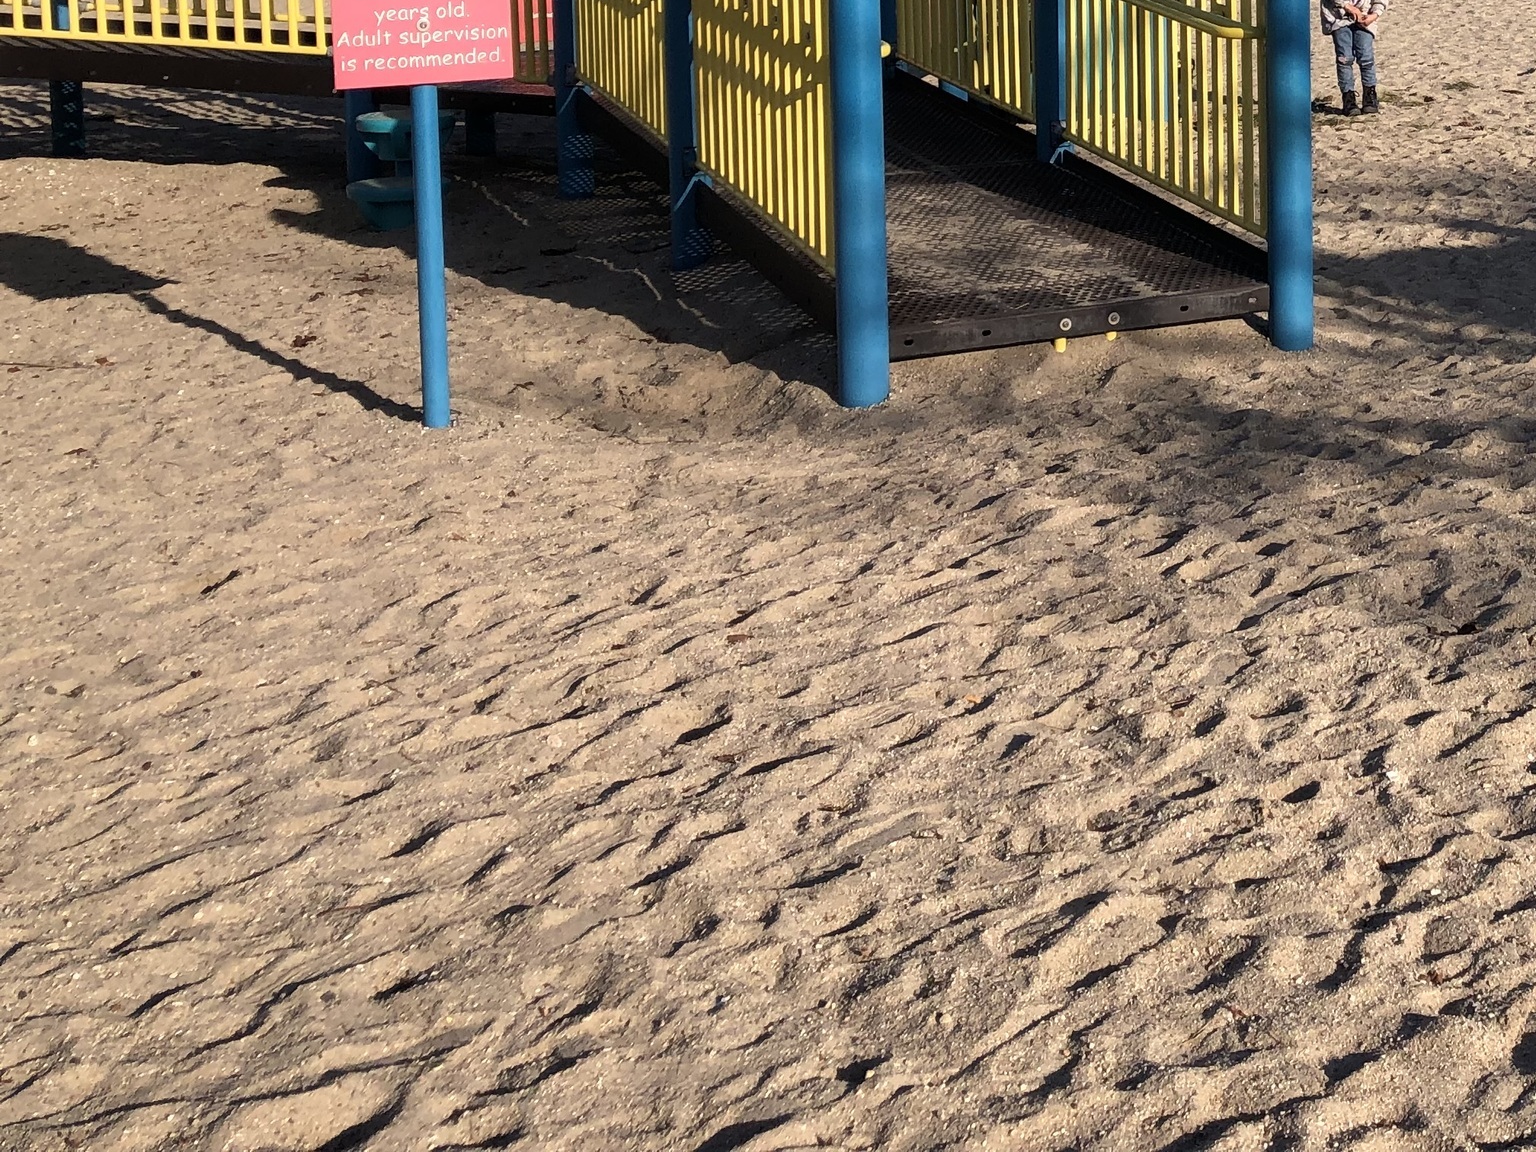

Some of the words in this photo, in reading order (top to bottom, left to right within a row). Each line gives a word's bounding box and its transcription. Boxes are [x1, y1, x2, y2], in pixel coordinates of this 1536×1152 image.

[374, 5, 429, 26] years
[436, 1, 470, 19] old.
[337, 29, 391, 48] Adult
[399, 26, 508, 48] supervision
[341, 55, 357, 72] is
[364, 46, 506, 71] recommended.
